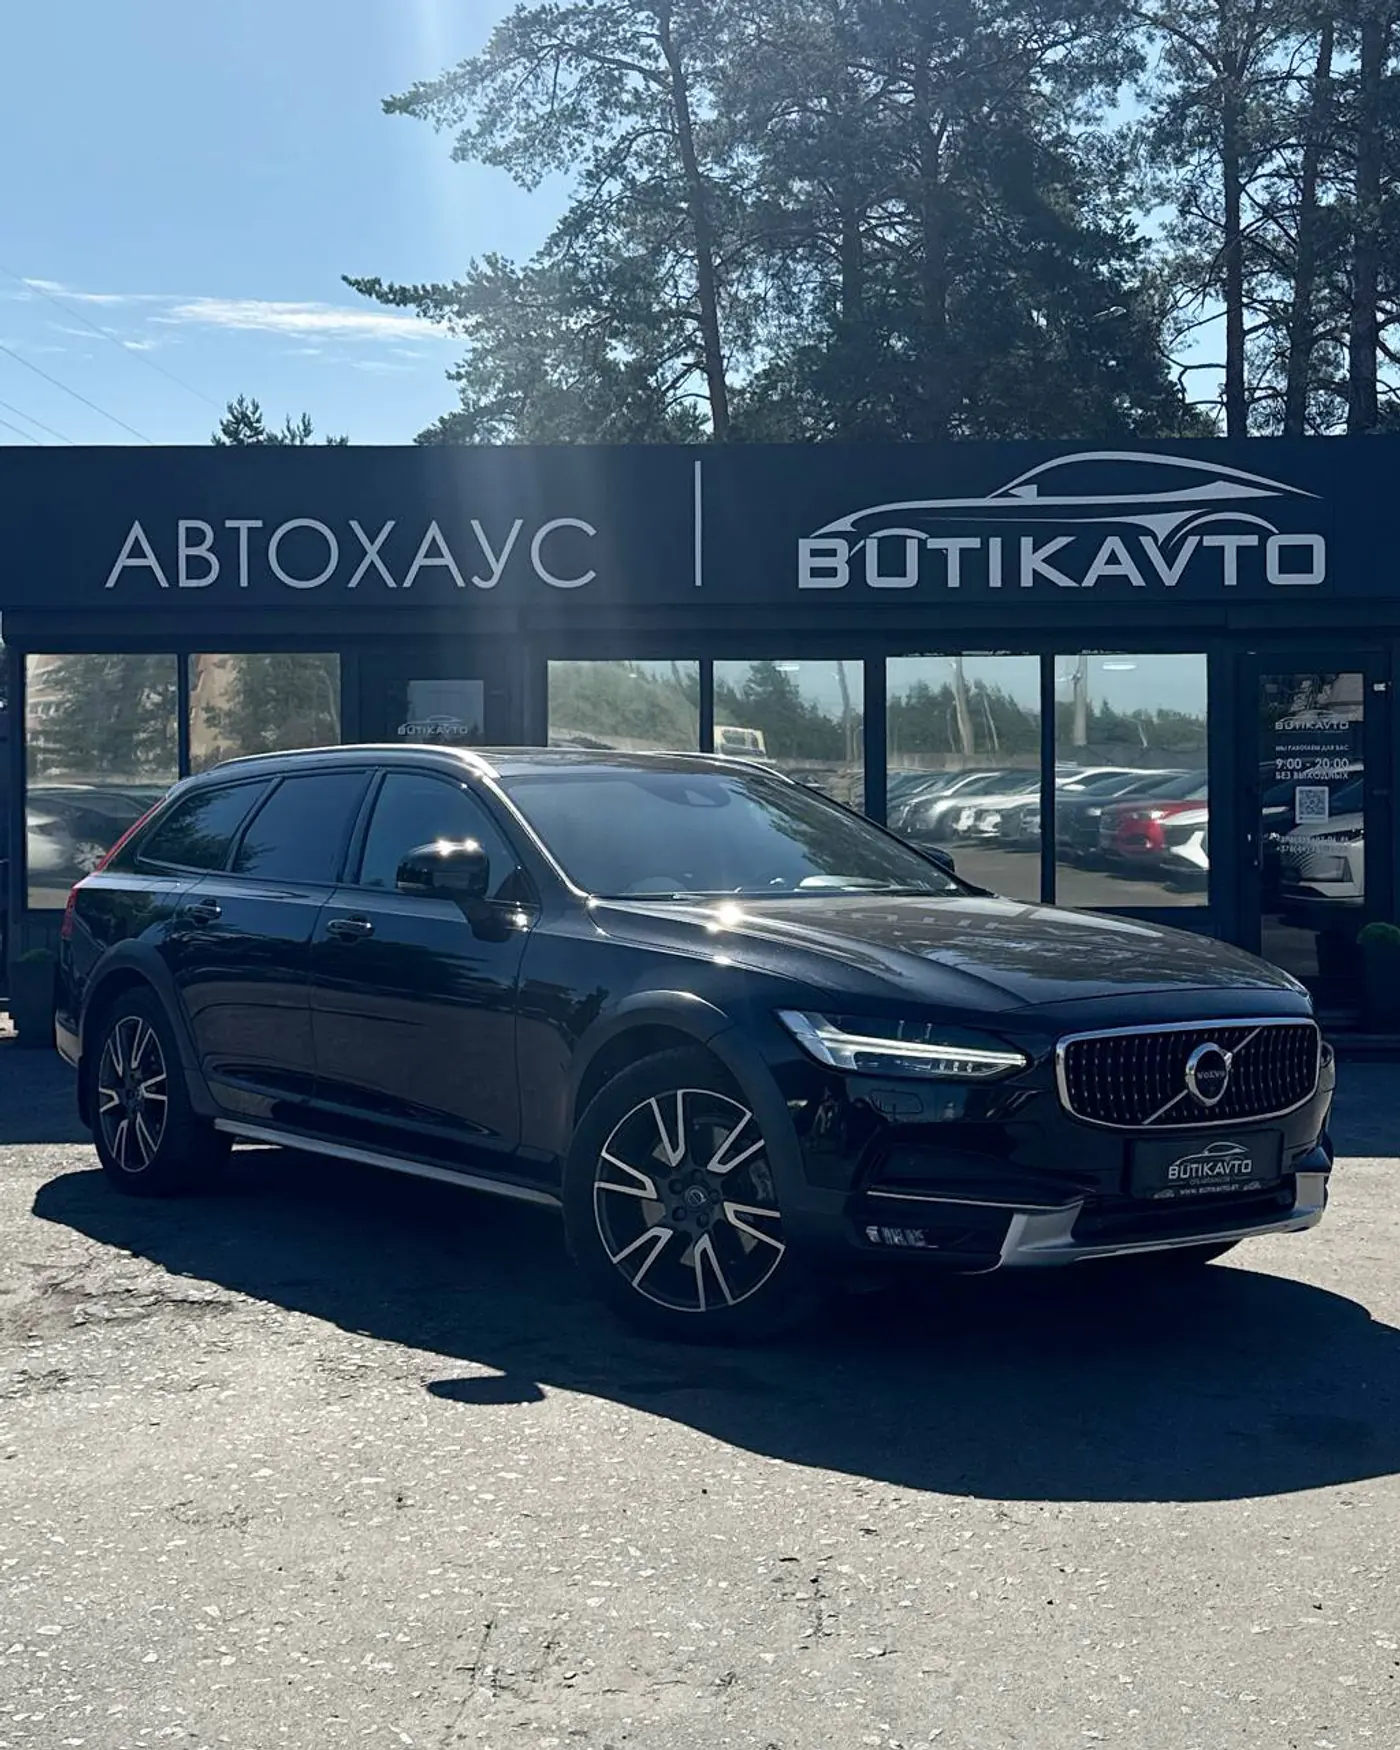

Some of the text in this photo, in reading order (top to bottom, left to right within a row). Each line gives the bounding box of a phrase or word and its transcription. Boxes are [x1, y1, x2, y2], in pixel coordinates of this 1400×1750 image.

[105, 518, 597, 590] АВТОХАУС
[798, 533, 1326, 589] BUTIKAVTO
[397, 726, 468, 735] BUTIKAVTO
[1275, 721, 1349, 730] BUTIKAVTO
[1275, 758, 1302, 770] 9:00
[1315, 757, 1350, 770] 20:00
[1275, 771, 1349, 780] БЕЗ ВЫХОДНЫХ
[1196, 1070, 1226, 1080] VOLVO
[1168, 1159, 1253, 1180] BUTIKAVTO
